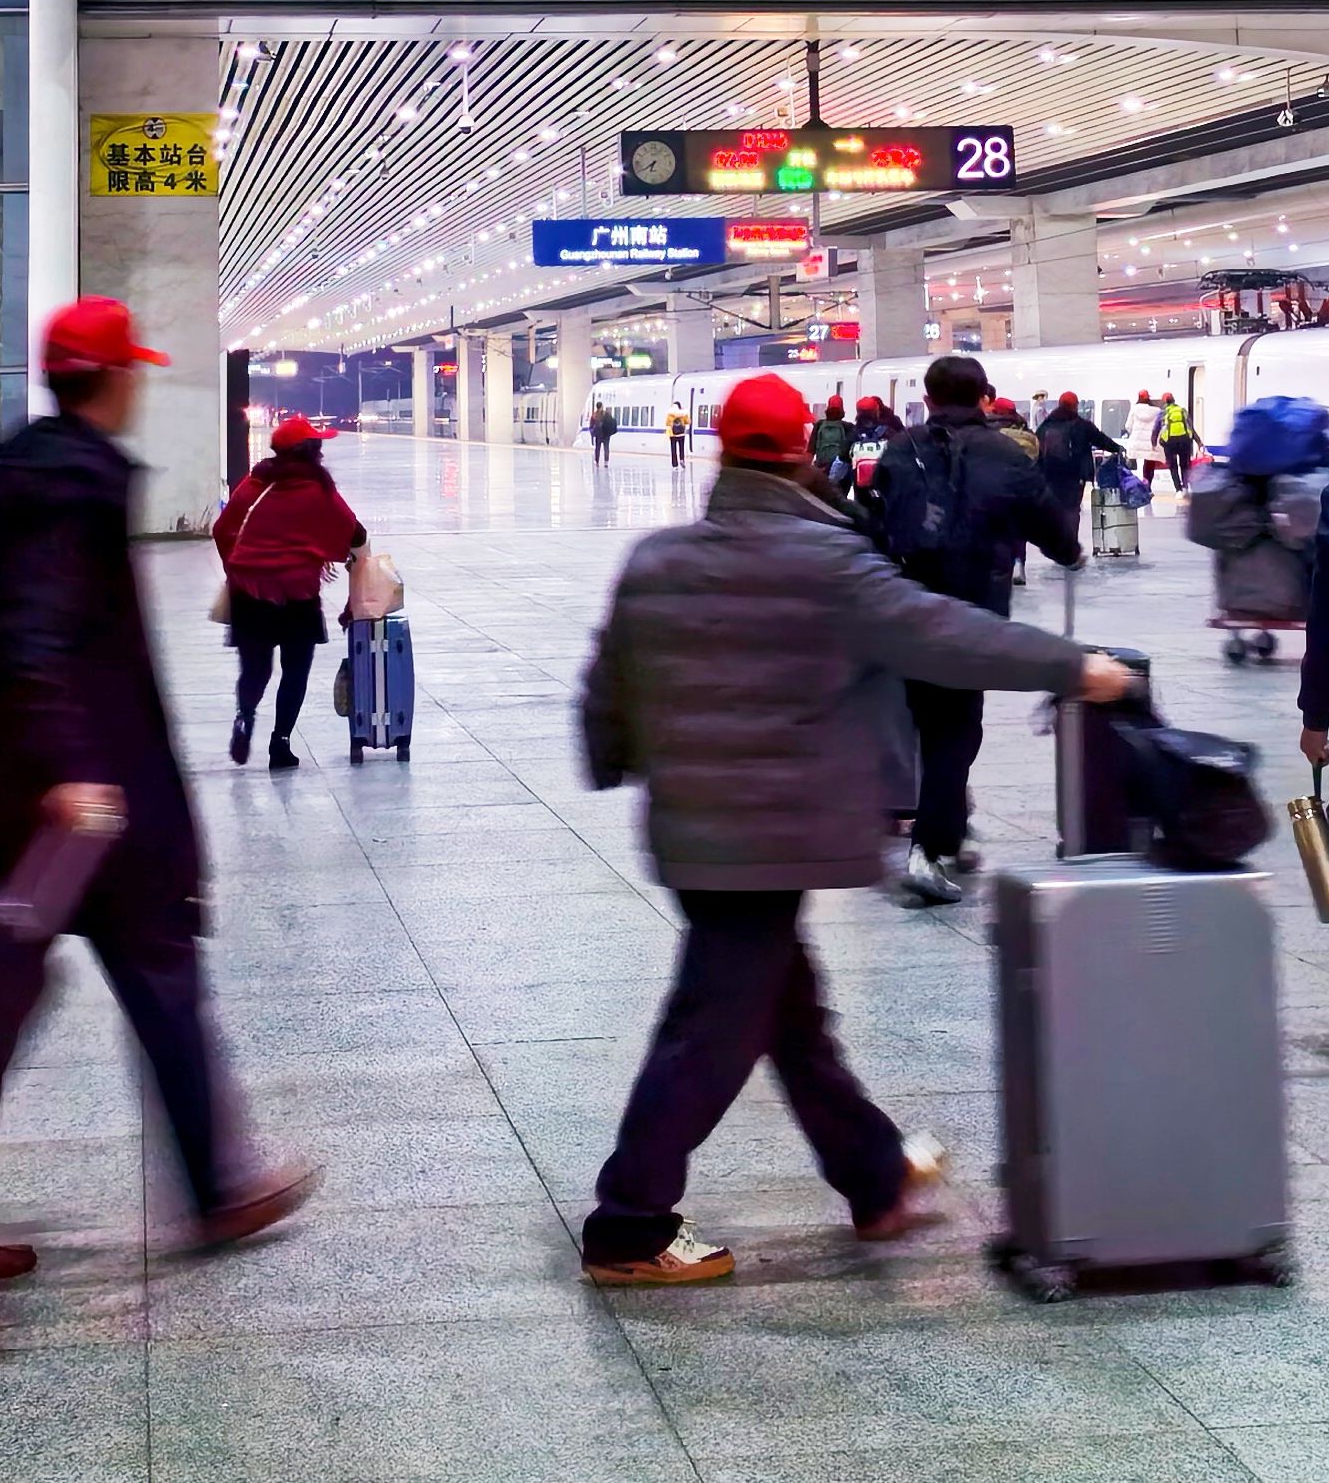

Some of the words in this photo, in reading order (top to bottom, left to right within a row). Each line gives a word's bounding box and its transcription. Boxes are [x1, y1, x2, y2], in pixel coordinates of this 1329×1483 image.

[107, 142, 207, 166] 基本站台
[956, 136, 1010, 178] 28
[107, 170, 207, 192] 限高4米
[592, 225, 668, 246] 广州南站
[630, 249, 666, 260] Railway
[667, 248, 699, 259] Station
[808, 325, 829, 340] 27
